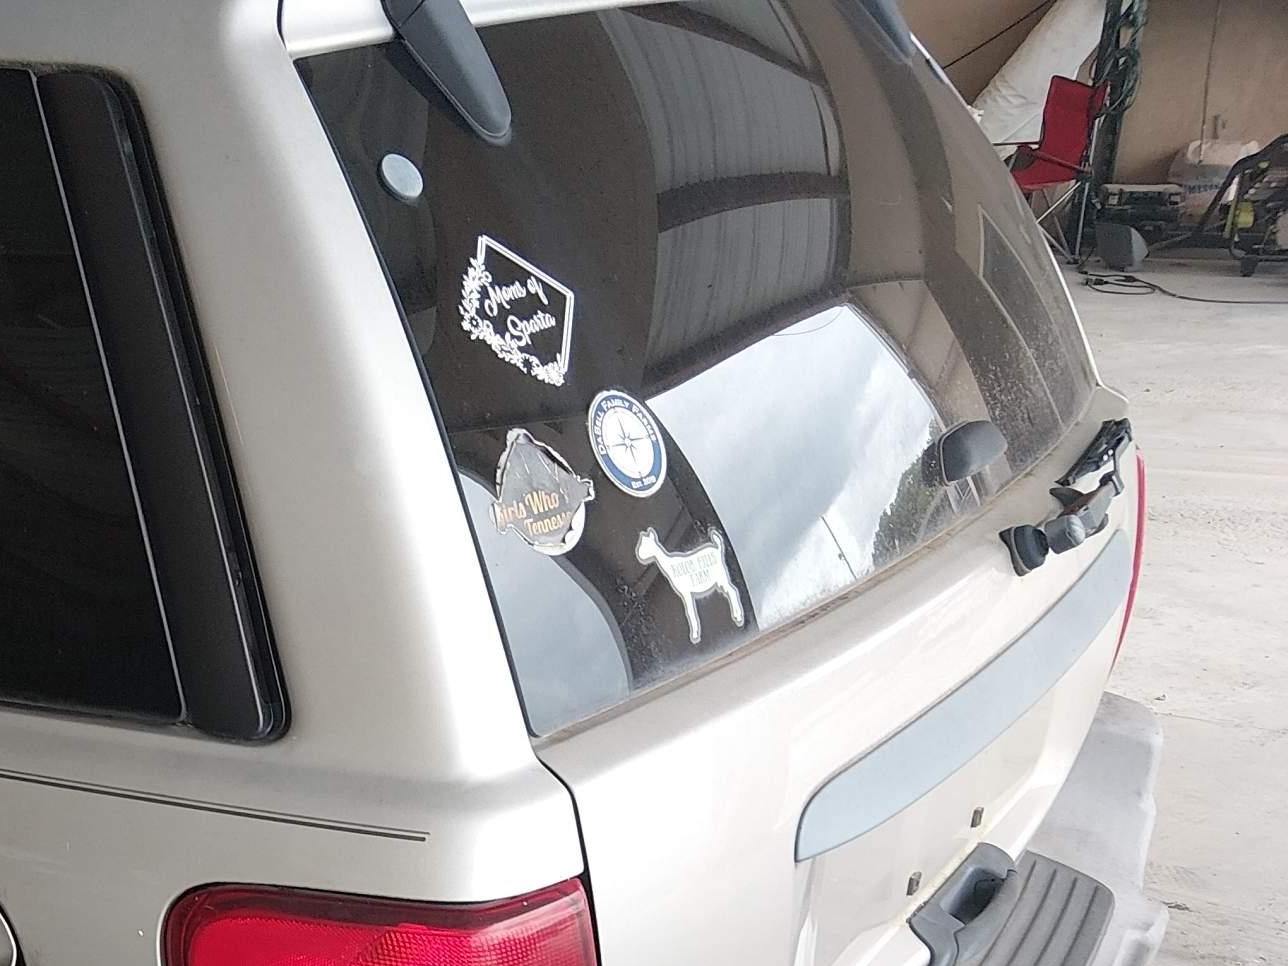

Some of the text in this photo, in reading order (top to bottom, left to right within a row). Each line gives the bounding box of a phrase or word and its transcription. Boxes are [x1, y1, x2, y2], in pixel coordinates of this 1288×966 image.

[484, 275, 549, 317] Moms of
[506, 309, 557, 347] Sparta
[524, 490, 560, 515] Who
